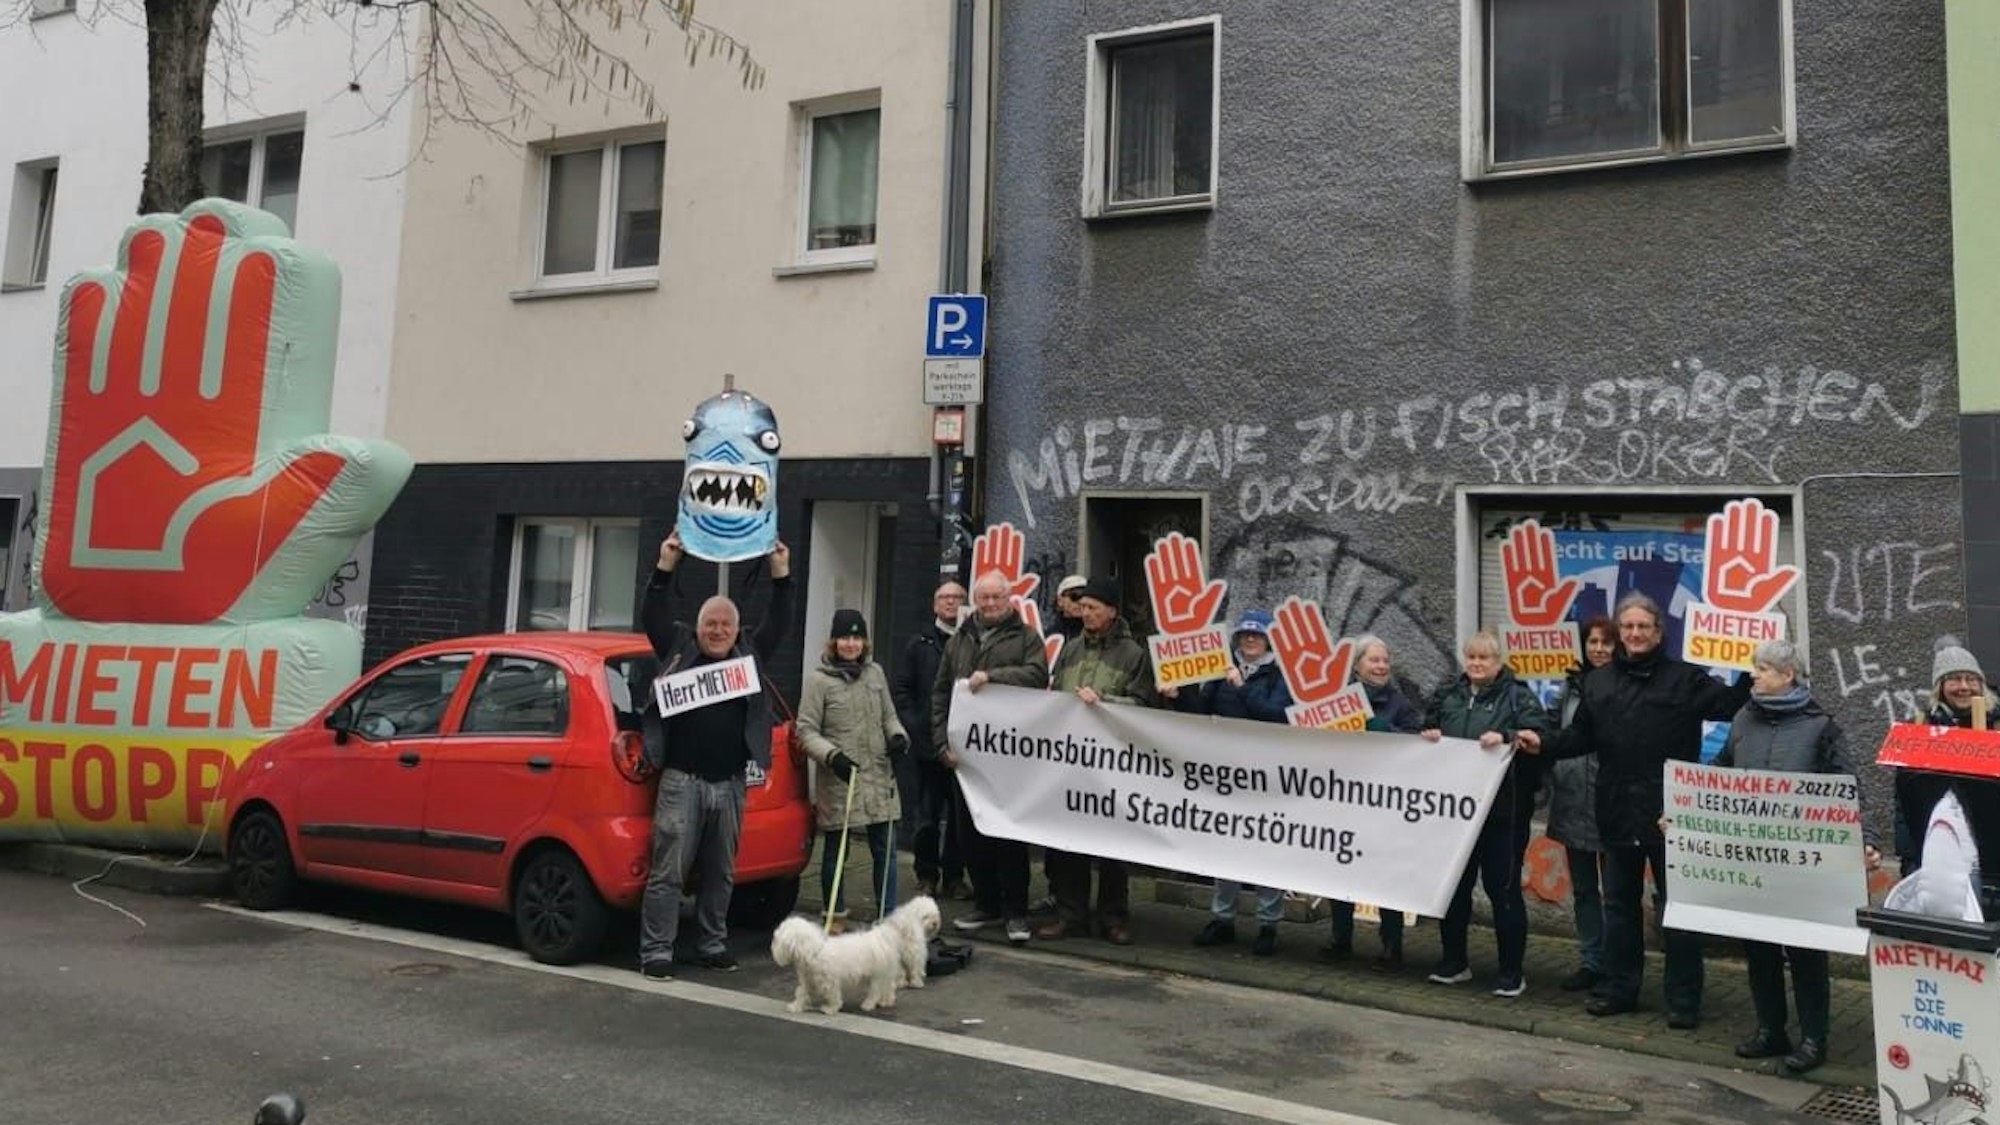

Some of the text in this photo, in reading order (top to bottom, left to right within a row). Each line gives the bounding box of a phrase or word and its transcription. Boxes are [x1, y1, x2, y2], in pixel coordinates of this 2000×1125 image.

[935, 303, 968, 350] P
[1295, 405, 1377, 464] ZU
[1612, 541, 1657, 562] auf
[1693, 610, 1777, 641] MIETEN
[1156, 631, 1224, 661] MIETEN
[1506, 631, 1573, 651] MIETEN
[1690, 635, 1758, 663] STOP
[1160, 653, 1227, 683] STOPP!
[0, 639, 279, 729] MIETEN
[661, 681, 696, 710] Herr
[1294, 692, 1364, 728] MIETEN
[965, 722, 1175, 778] Aktionsbündnis
[1183, 760, 1268, 796] gegen
[1673, 768, 1857, 800] MAHNWACHEN 2022/23
[1697, 792, 1802, 820] LEERSTÄNDEN
[1804, 806, 1824, 822] IN
[1066, 787, 1364, 864] und Stadtzerstörung.
[1874, 942, 1985, 984] MIETHAI
[1915, 978, 1938, 996] IN
[1914, 997, 1946, 1017] DIE
[1900, 1013, 1964, 1040] TONNE
